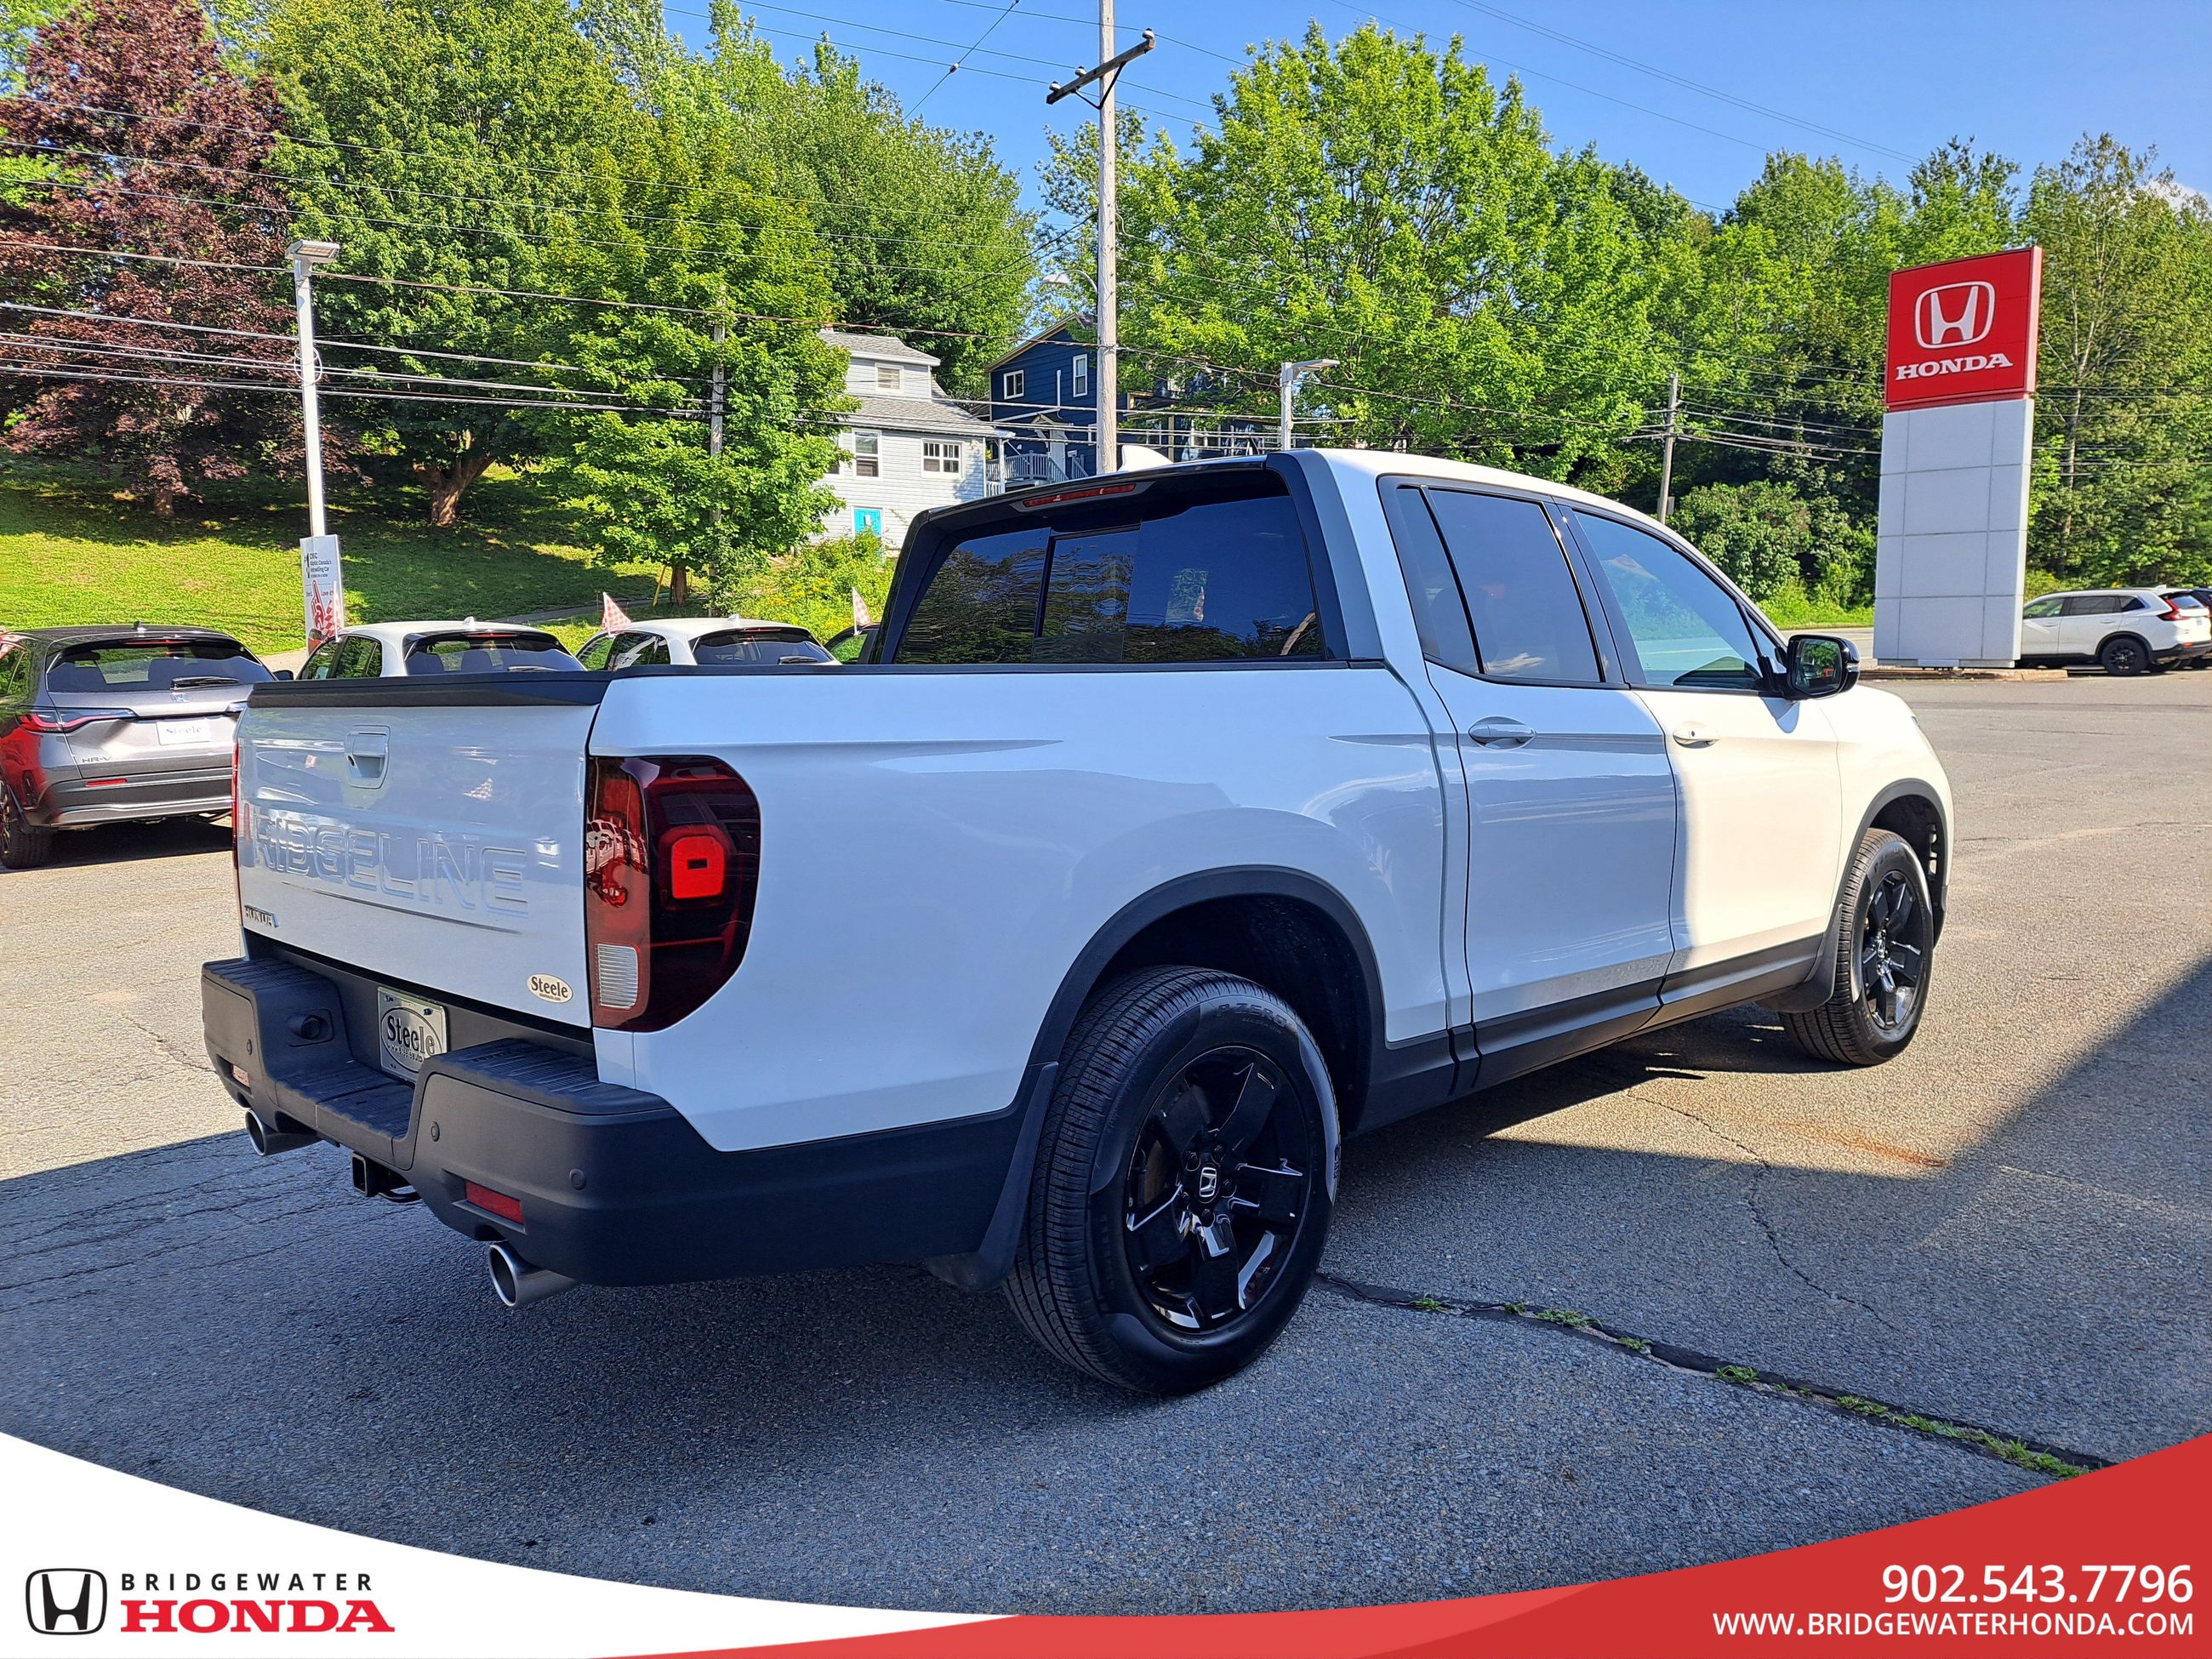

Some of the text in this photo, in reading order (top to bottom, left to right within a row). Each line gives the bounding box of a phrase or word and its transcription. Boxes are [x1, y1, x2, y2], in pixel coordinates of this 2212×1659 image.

[1896, 353, 2014, 381] HONDA
[82, 755, 112, 764] HR-V
[254, 813, 531, 920] RIDGELINE
[531, 976, 568, 999] Steele
[1234, 1002, 1287, 1029] ZERO
[386, 1015, 436, 1055] Steele
